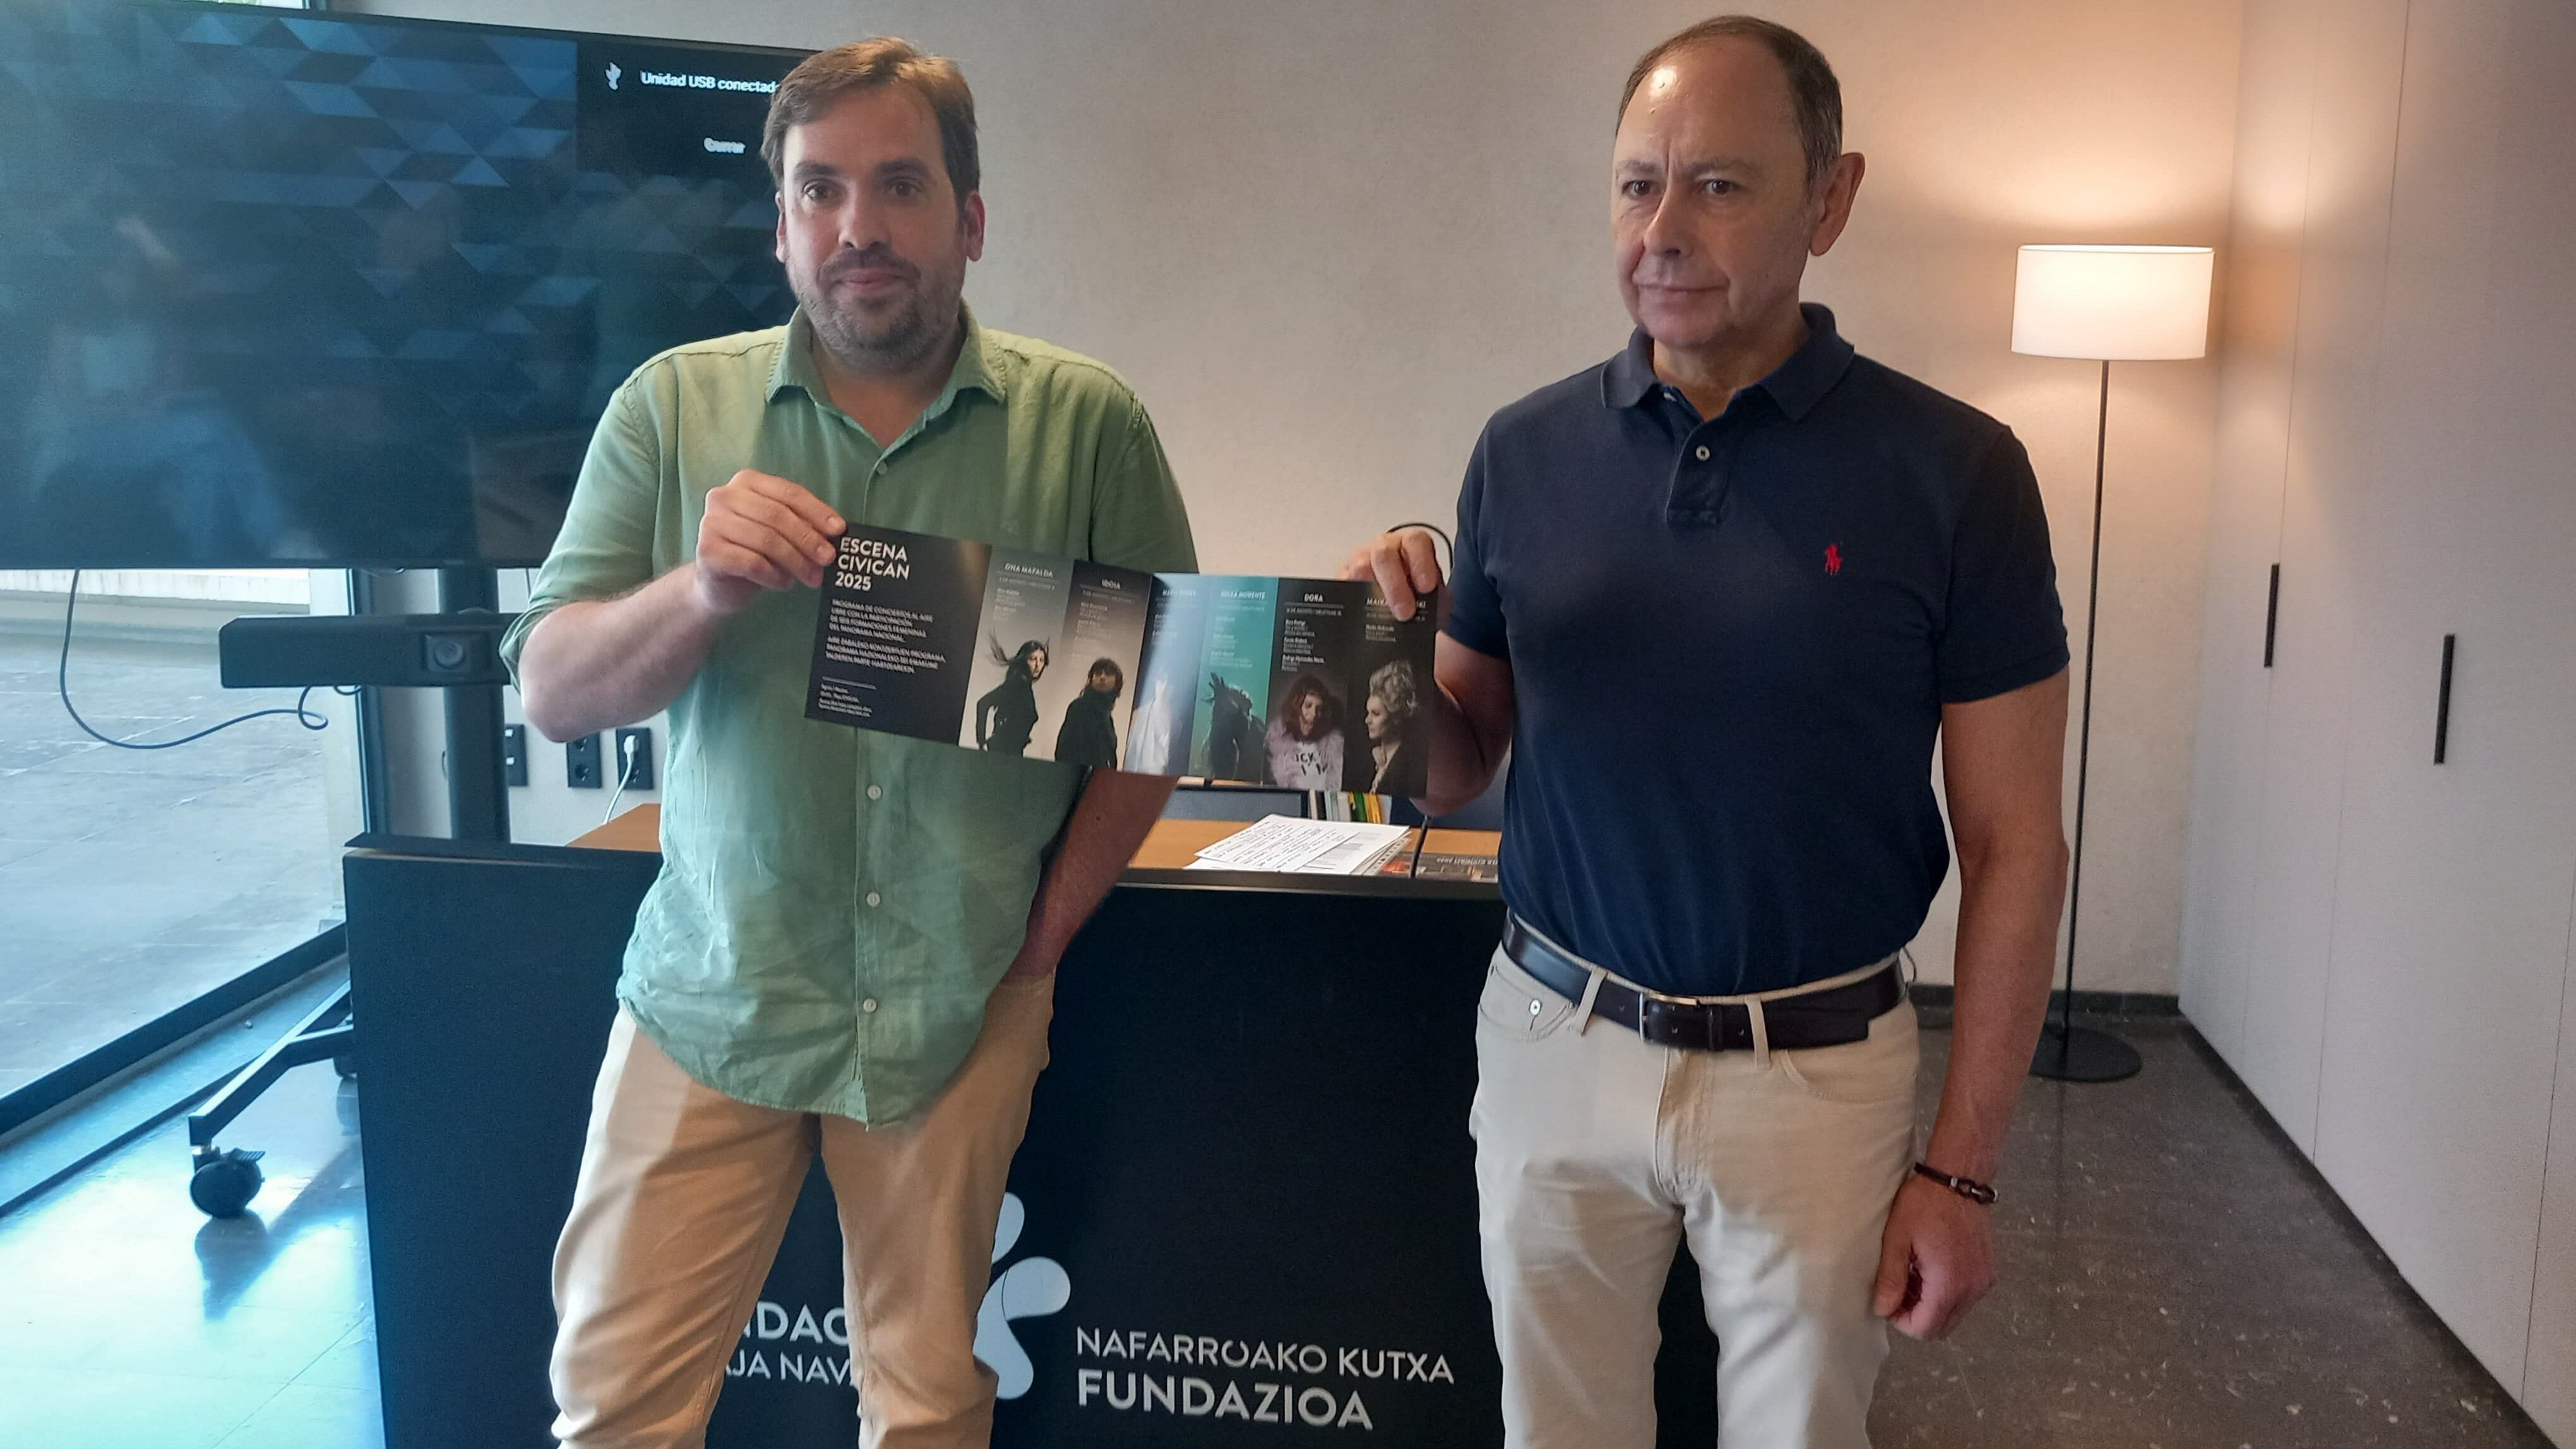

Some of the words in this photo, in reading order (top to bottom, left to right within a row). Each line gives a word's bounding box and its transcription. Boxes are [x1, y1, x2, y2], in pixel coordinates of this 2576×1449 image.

[640, 69, 686, 87] Unidad
[688, 75, 716, 89] USB
[840, 537, 907, 562] ESCENA
[838, 554, 910, 580] CIVICAN
[835, 571, 871, 591] 2025
[726, 1349, 772, 1380] JA
[780, 1351, 850, 1386] NAV
[1076, 1326, 1327, 1374] NAFARROAKO
[1339, 1346, 1454, 1385] KUTXA
[1078, 1368, 1373, 1431] FUNDAZIOA
